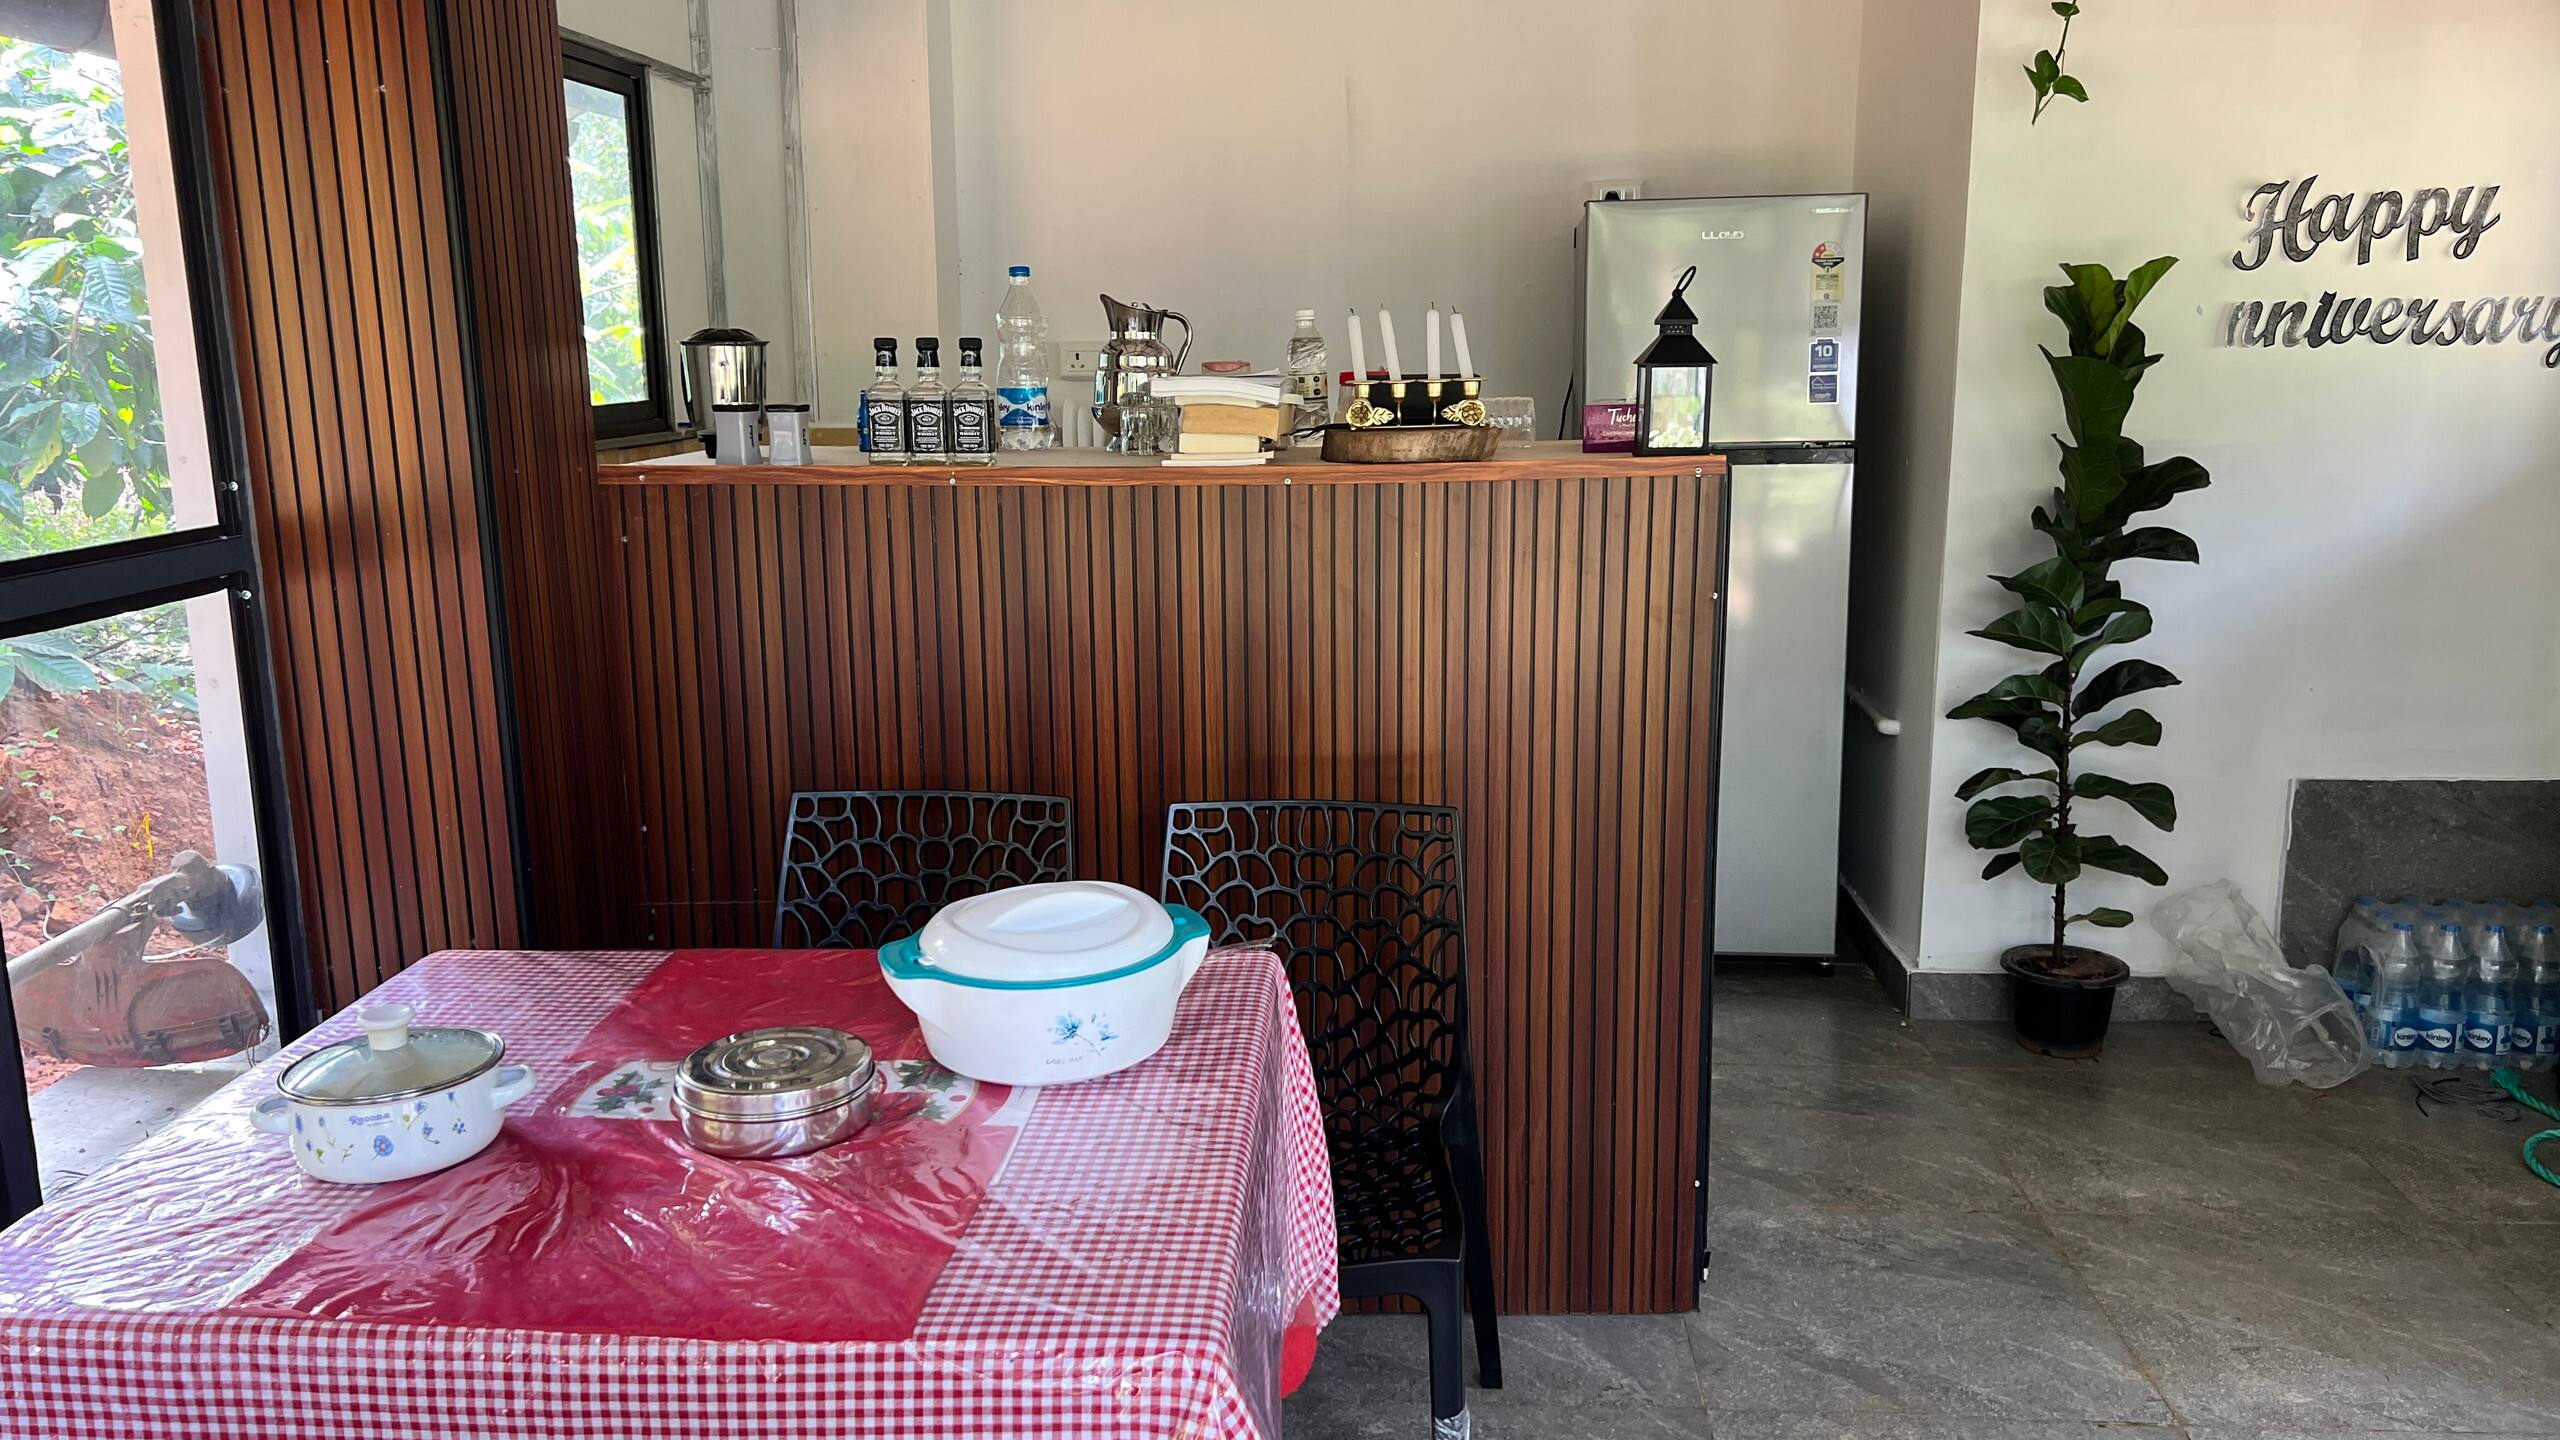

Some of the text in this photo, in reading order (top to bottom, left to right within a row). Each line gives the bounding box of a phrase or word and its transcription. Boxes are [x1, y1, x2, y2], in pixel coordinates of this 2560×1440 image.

[2233, 175, 2500, 271] Happy
[1702, 231, 1744, 240] LLOYD
[1815, 345, 1833, 357] 10
